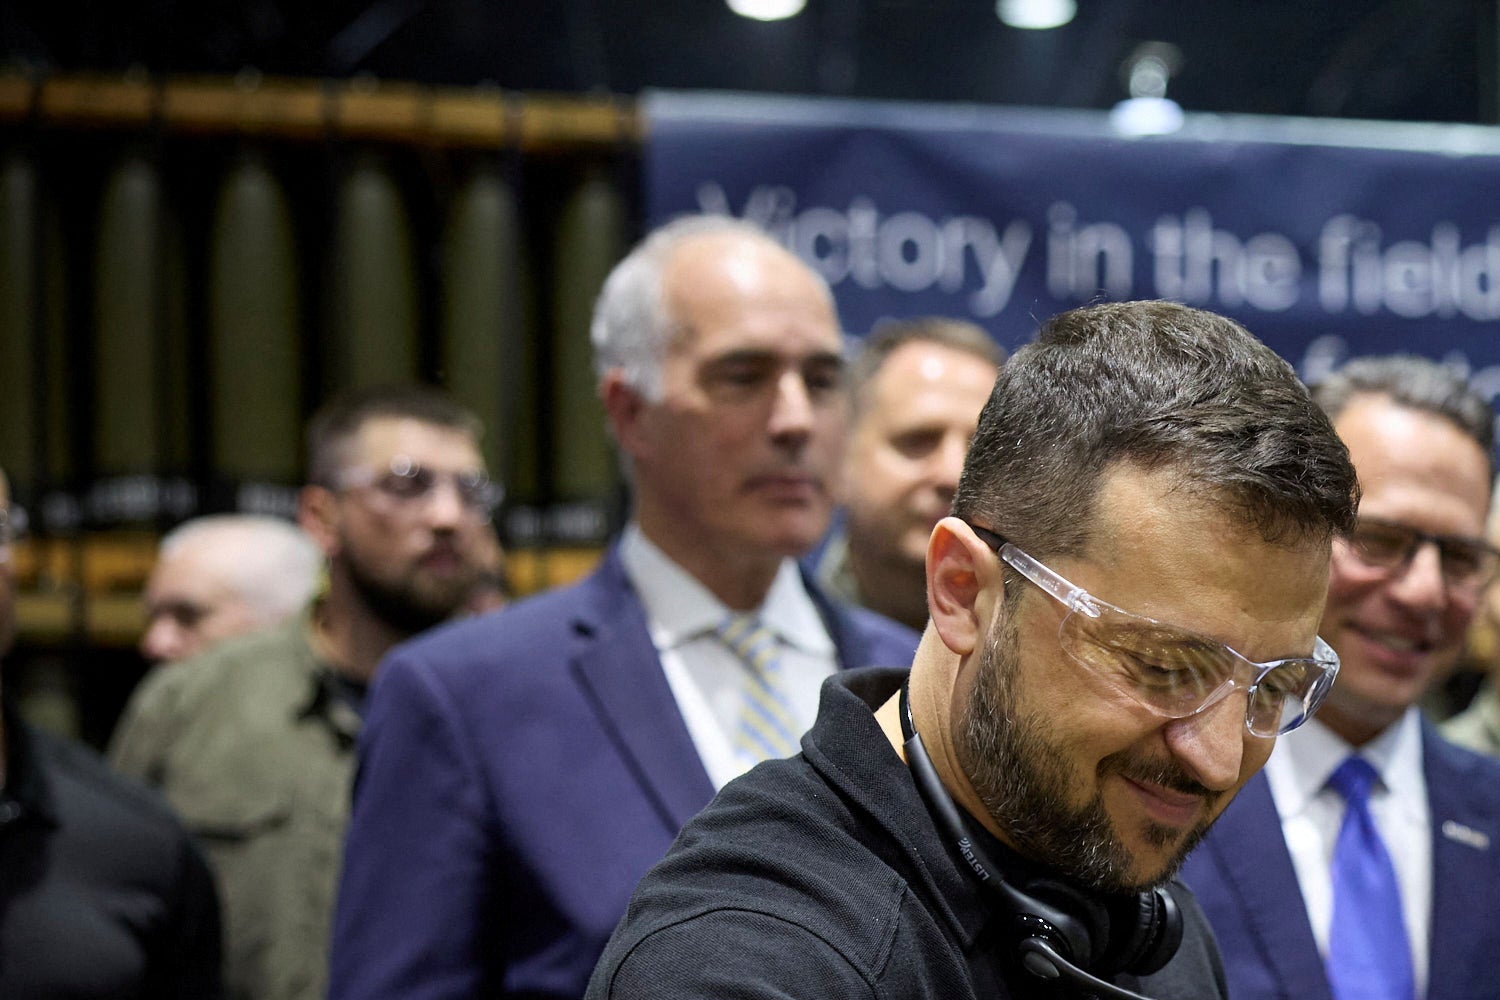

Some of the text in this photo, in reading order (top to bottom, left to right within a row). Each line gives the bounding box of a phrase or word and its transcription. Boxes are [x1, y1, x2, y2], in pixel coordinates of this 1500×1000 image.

[1046, 201, 1134, 301] in
[1150, 206, 1301, 312] the
[960, 846, 990, 880] LISTEN
